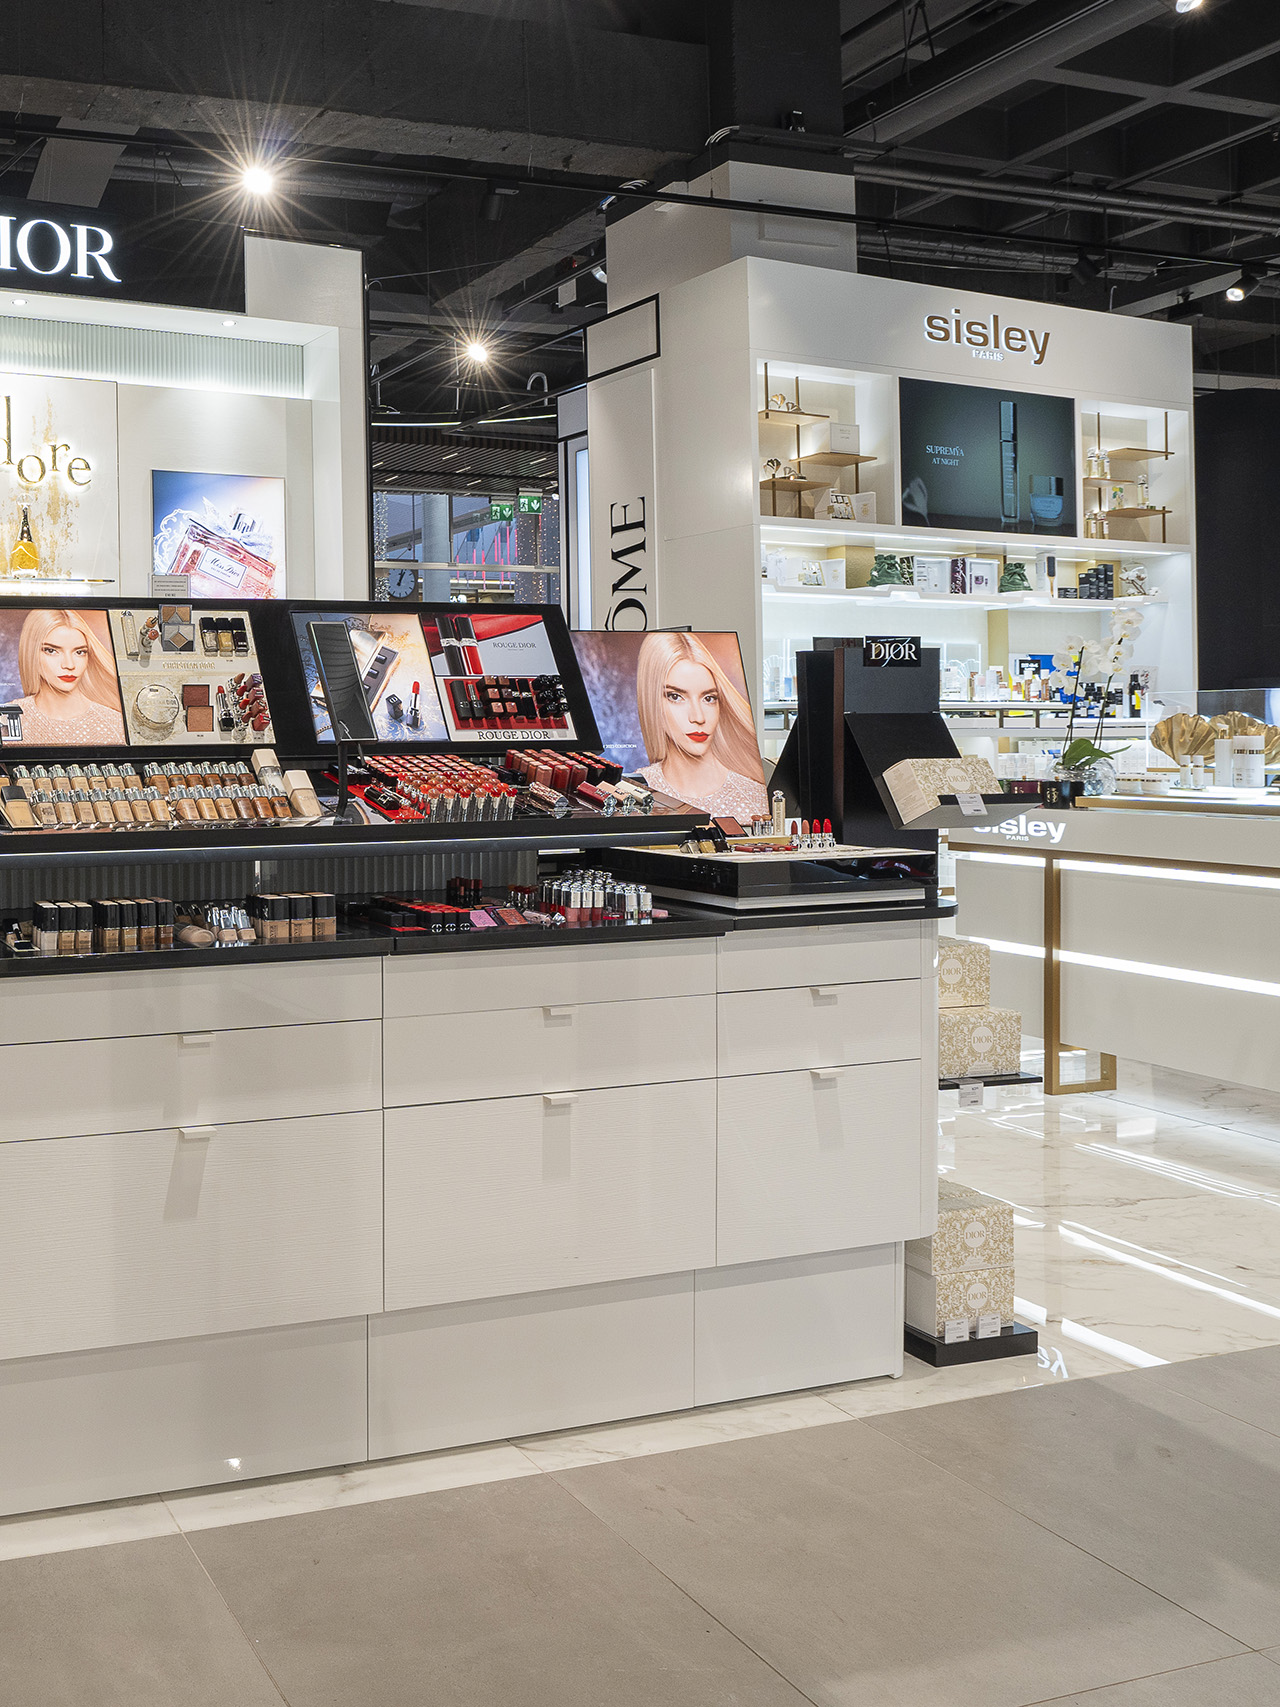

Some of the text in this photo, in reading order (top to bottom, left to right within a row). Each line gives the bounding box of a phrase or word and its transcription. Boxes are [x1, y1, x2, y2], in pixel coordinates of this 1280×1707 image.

[924, 307, 1050, 366] sisley
[972, 350, 1005, 362] PARIS
[941, 458, 960, 467] NIGHT
[870, 642, 917, 660] DIOR
[478, 731, 550, 740] ROUGE DIOR
[949, 774, 970, 784] DIOR
[942, 968, 962, 976] DIOR
[972, 1036, 992, 1044] DIOR
[965, 1230, 985, 1240] DIOR
[968, 1292, 988, 1300] DIOR
